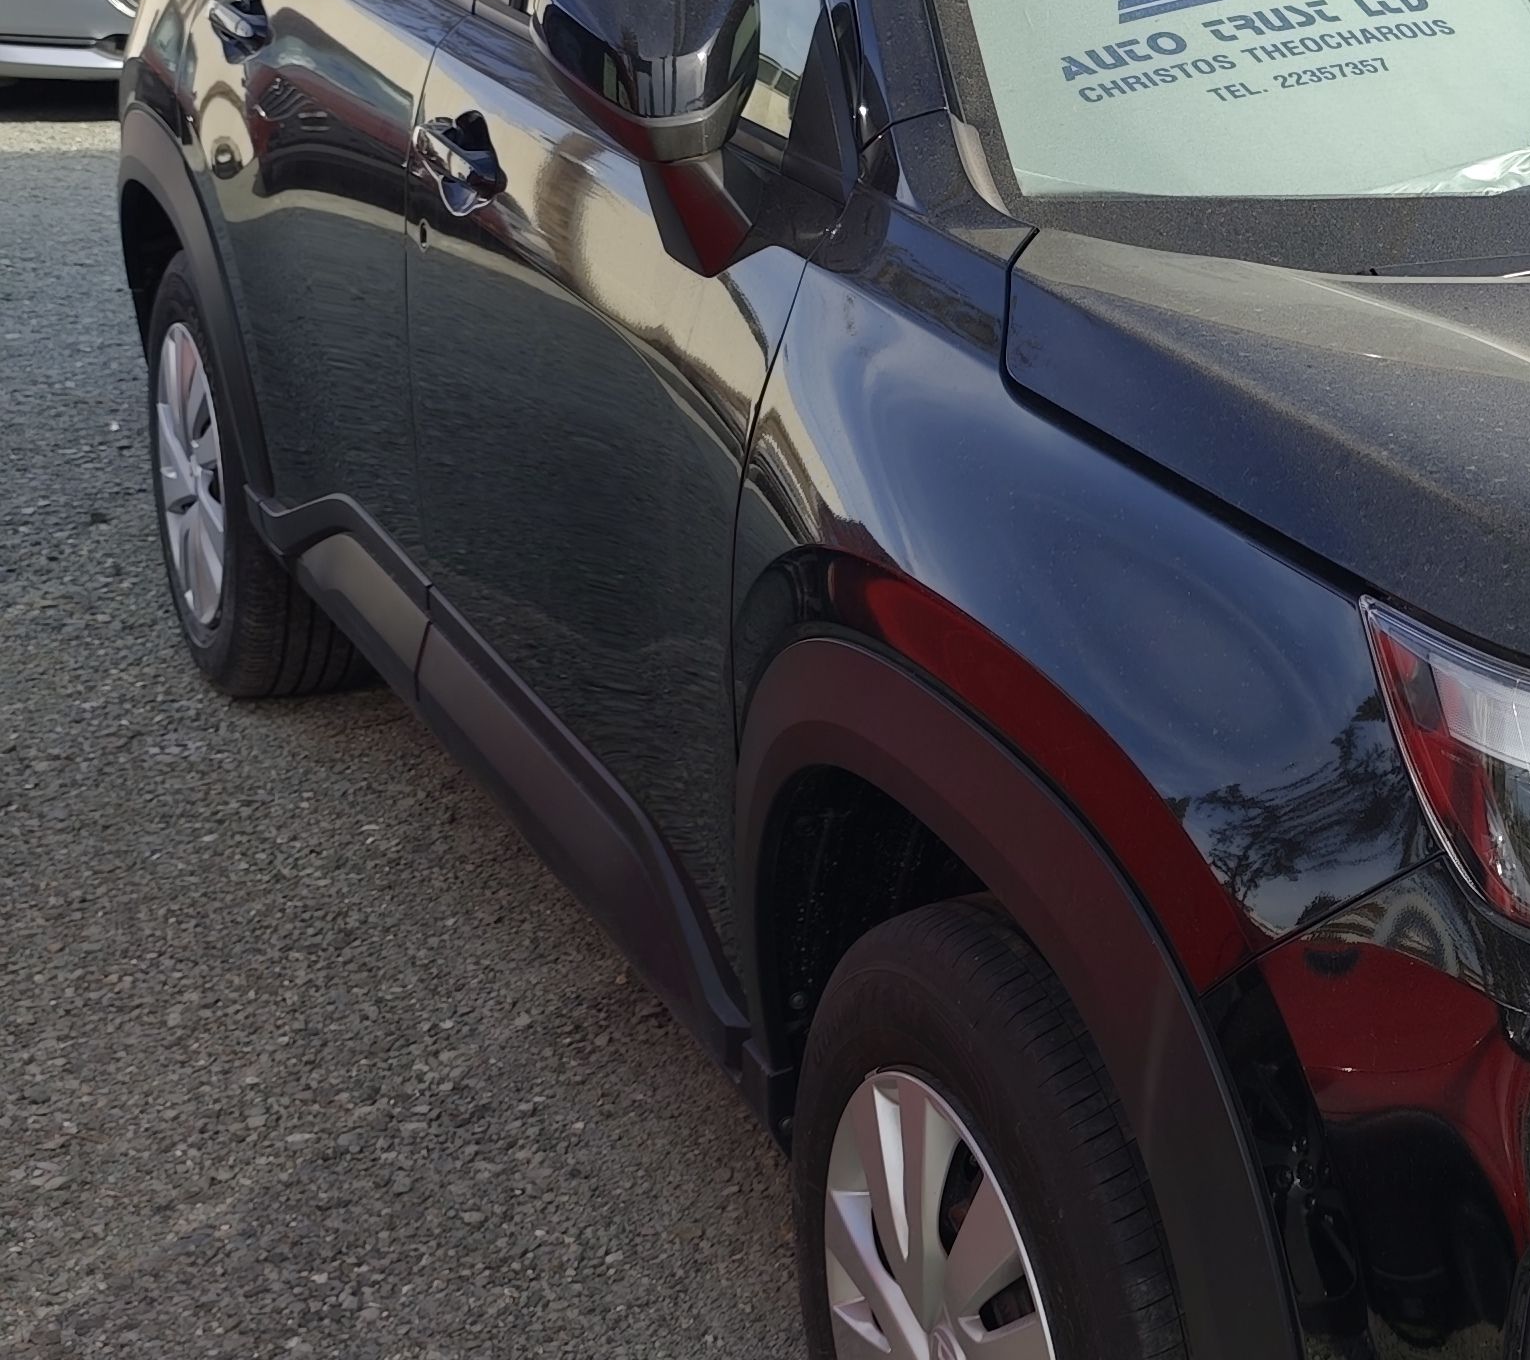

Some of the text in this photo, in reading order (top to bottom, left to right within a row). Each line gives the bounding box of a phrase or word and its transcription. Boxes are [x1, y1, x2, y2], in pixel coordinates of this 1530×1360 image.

[1061, 31, 1187, 81] AUTO
[1202, 0, 1342, 42] TRUST
[1078, 19, 1456, 103] CHRISTOS THEOCHAROUS
[1207, 57, 1390, 102] TEL. 22357357
